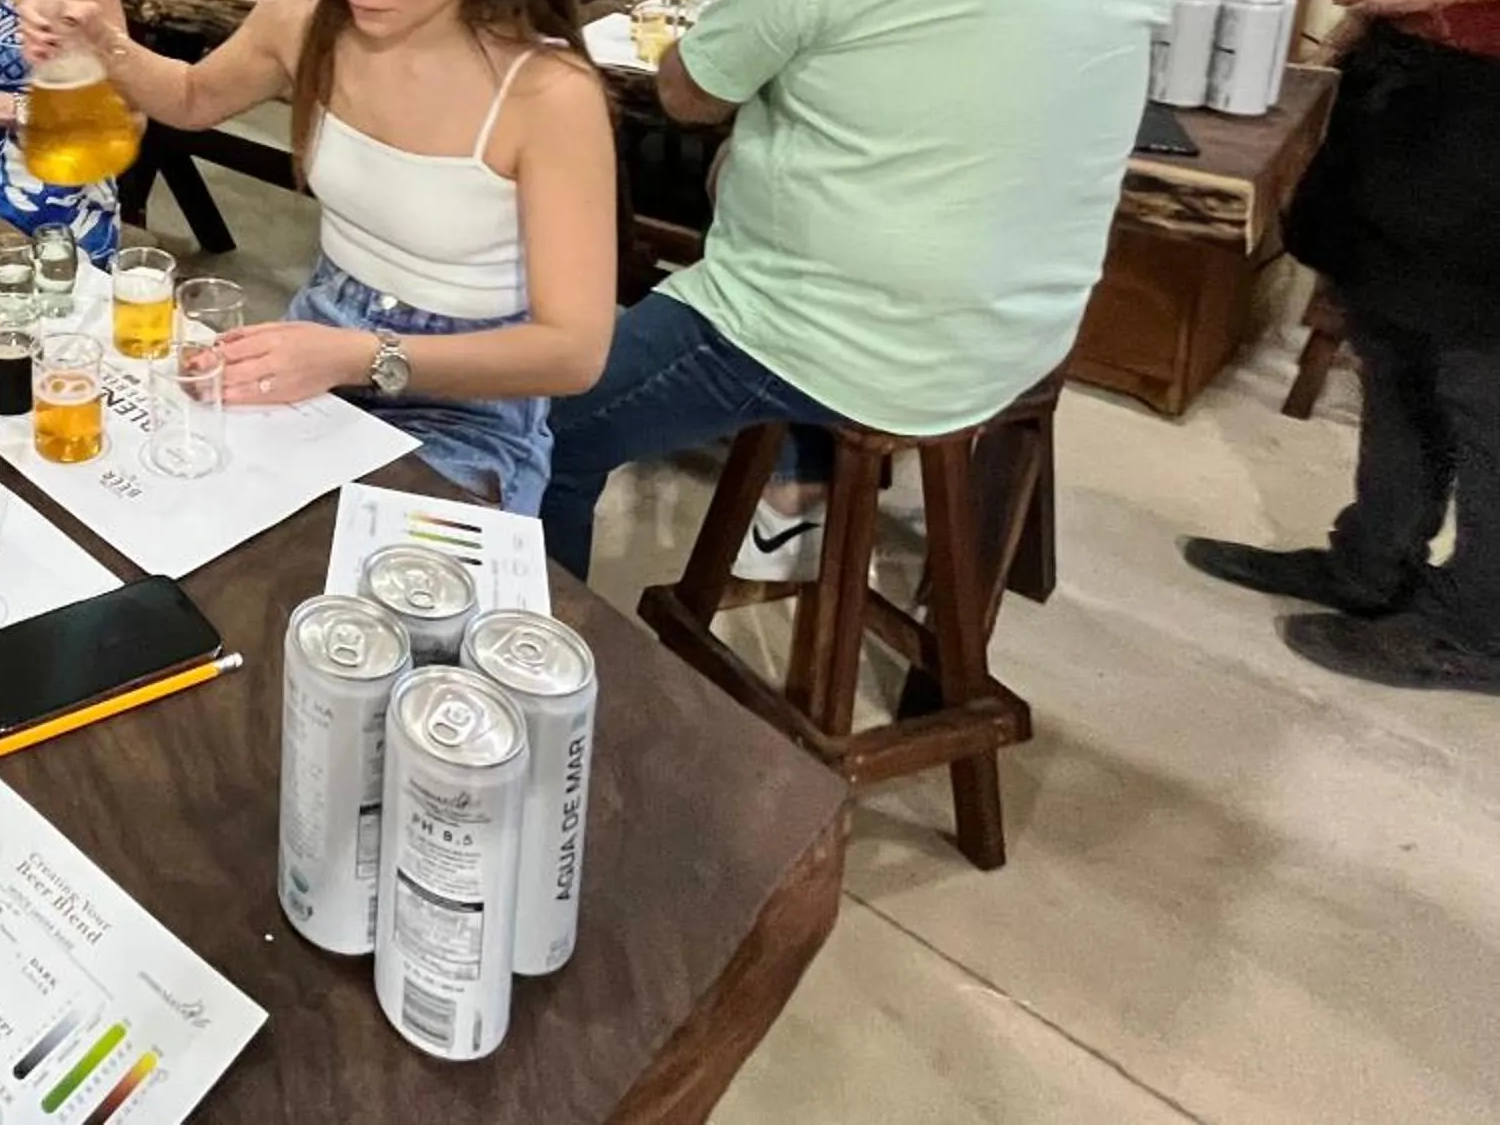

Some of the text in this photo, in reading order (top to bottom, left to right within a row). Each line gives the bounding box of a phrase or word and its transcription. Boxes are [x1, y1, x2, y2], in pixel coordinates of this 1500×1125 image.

[556, 734, 586, 900] AGUA DE MAR
[16, 860, 53, 896] Beer
[52, 895, 103, 946] Blend
